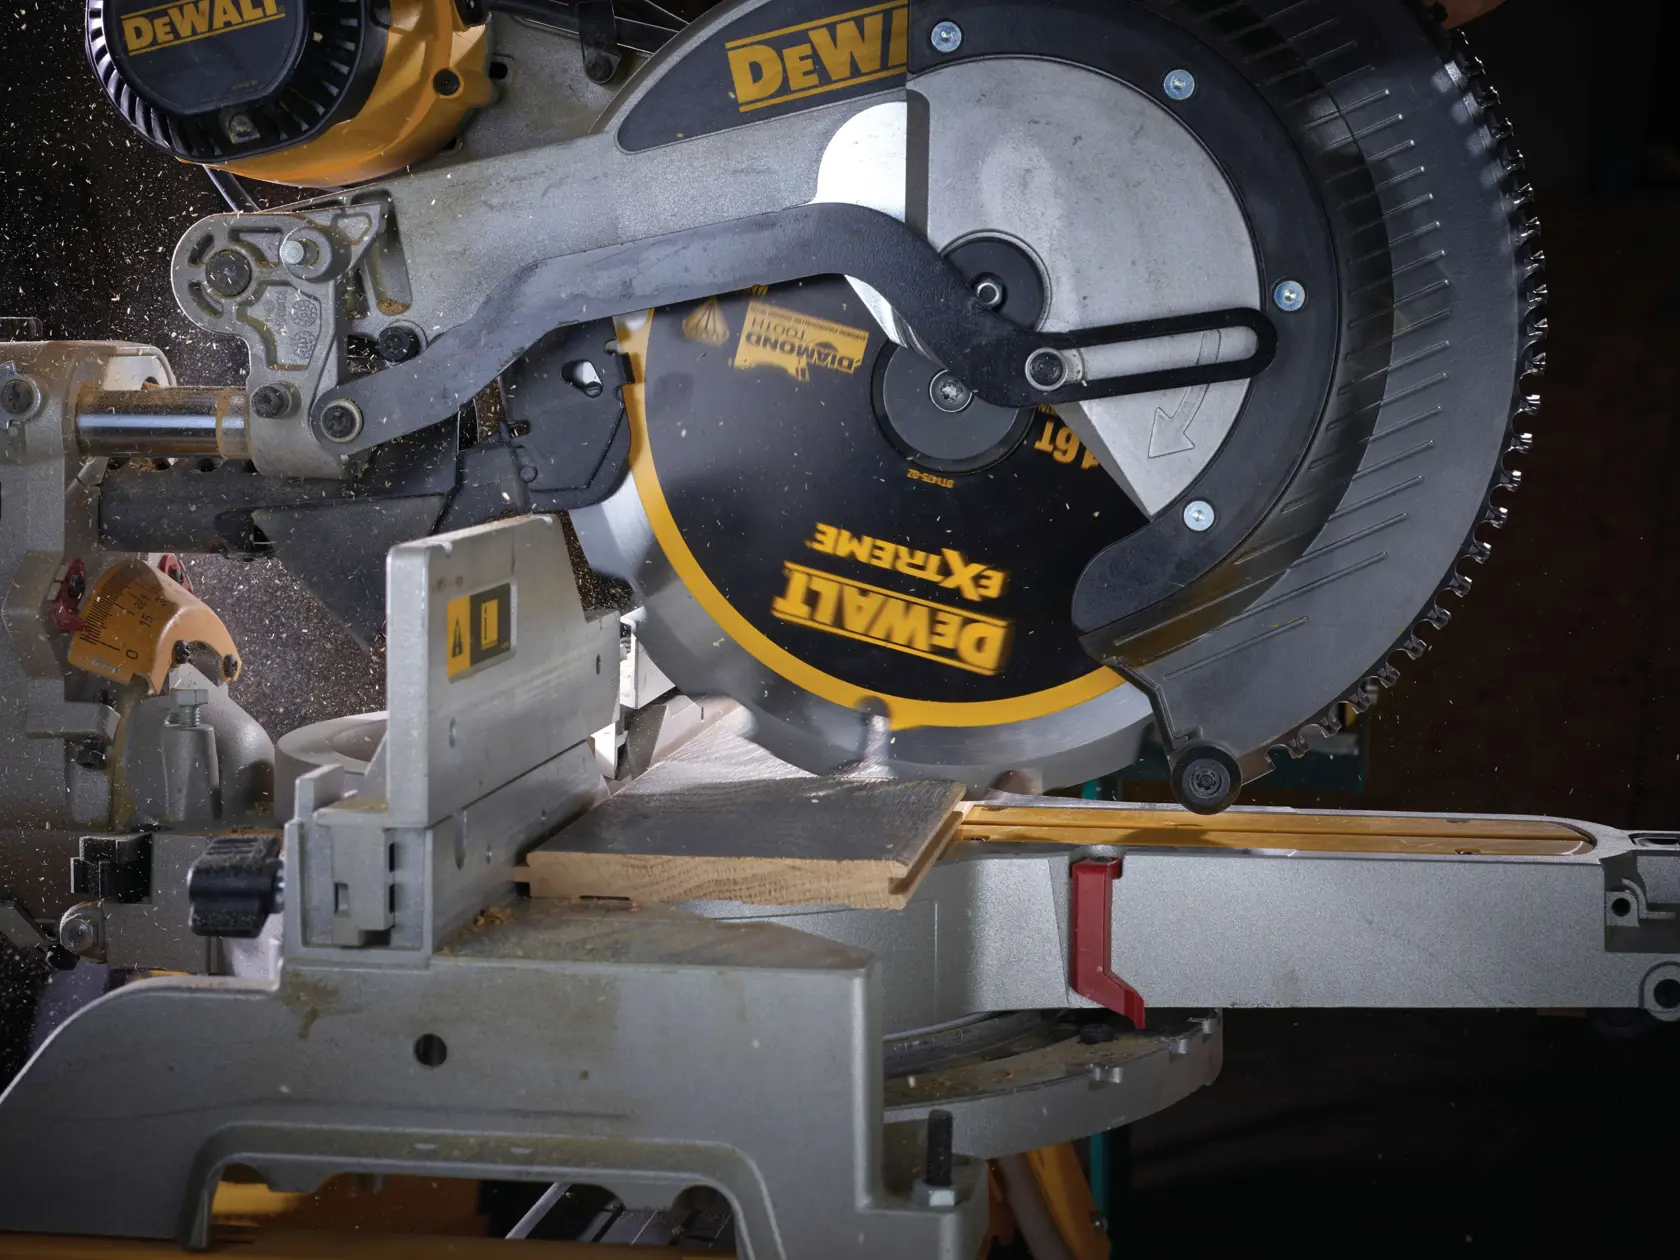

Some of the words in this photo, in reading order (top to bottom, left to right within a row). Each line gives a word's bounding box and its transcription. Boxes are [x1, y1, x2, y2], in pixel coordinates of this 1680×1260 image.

[745, 332, 855, 371] DIAMOND
[809, 522, 1009, 602] EXTREME
[139, 613, 154, 627] 15
[771, 570, 1013, 672] DEWALT
[126, 649, 139, 660] 0
